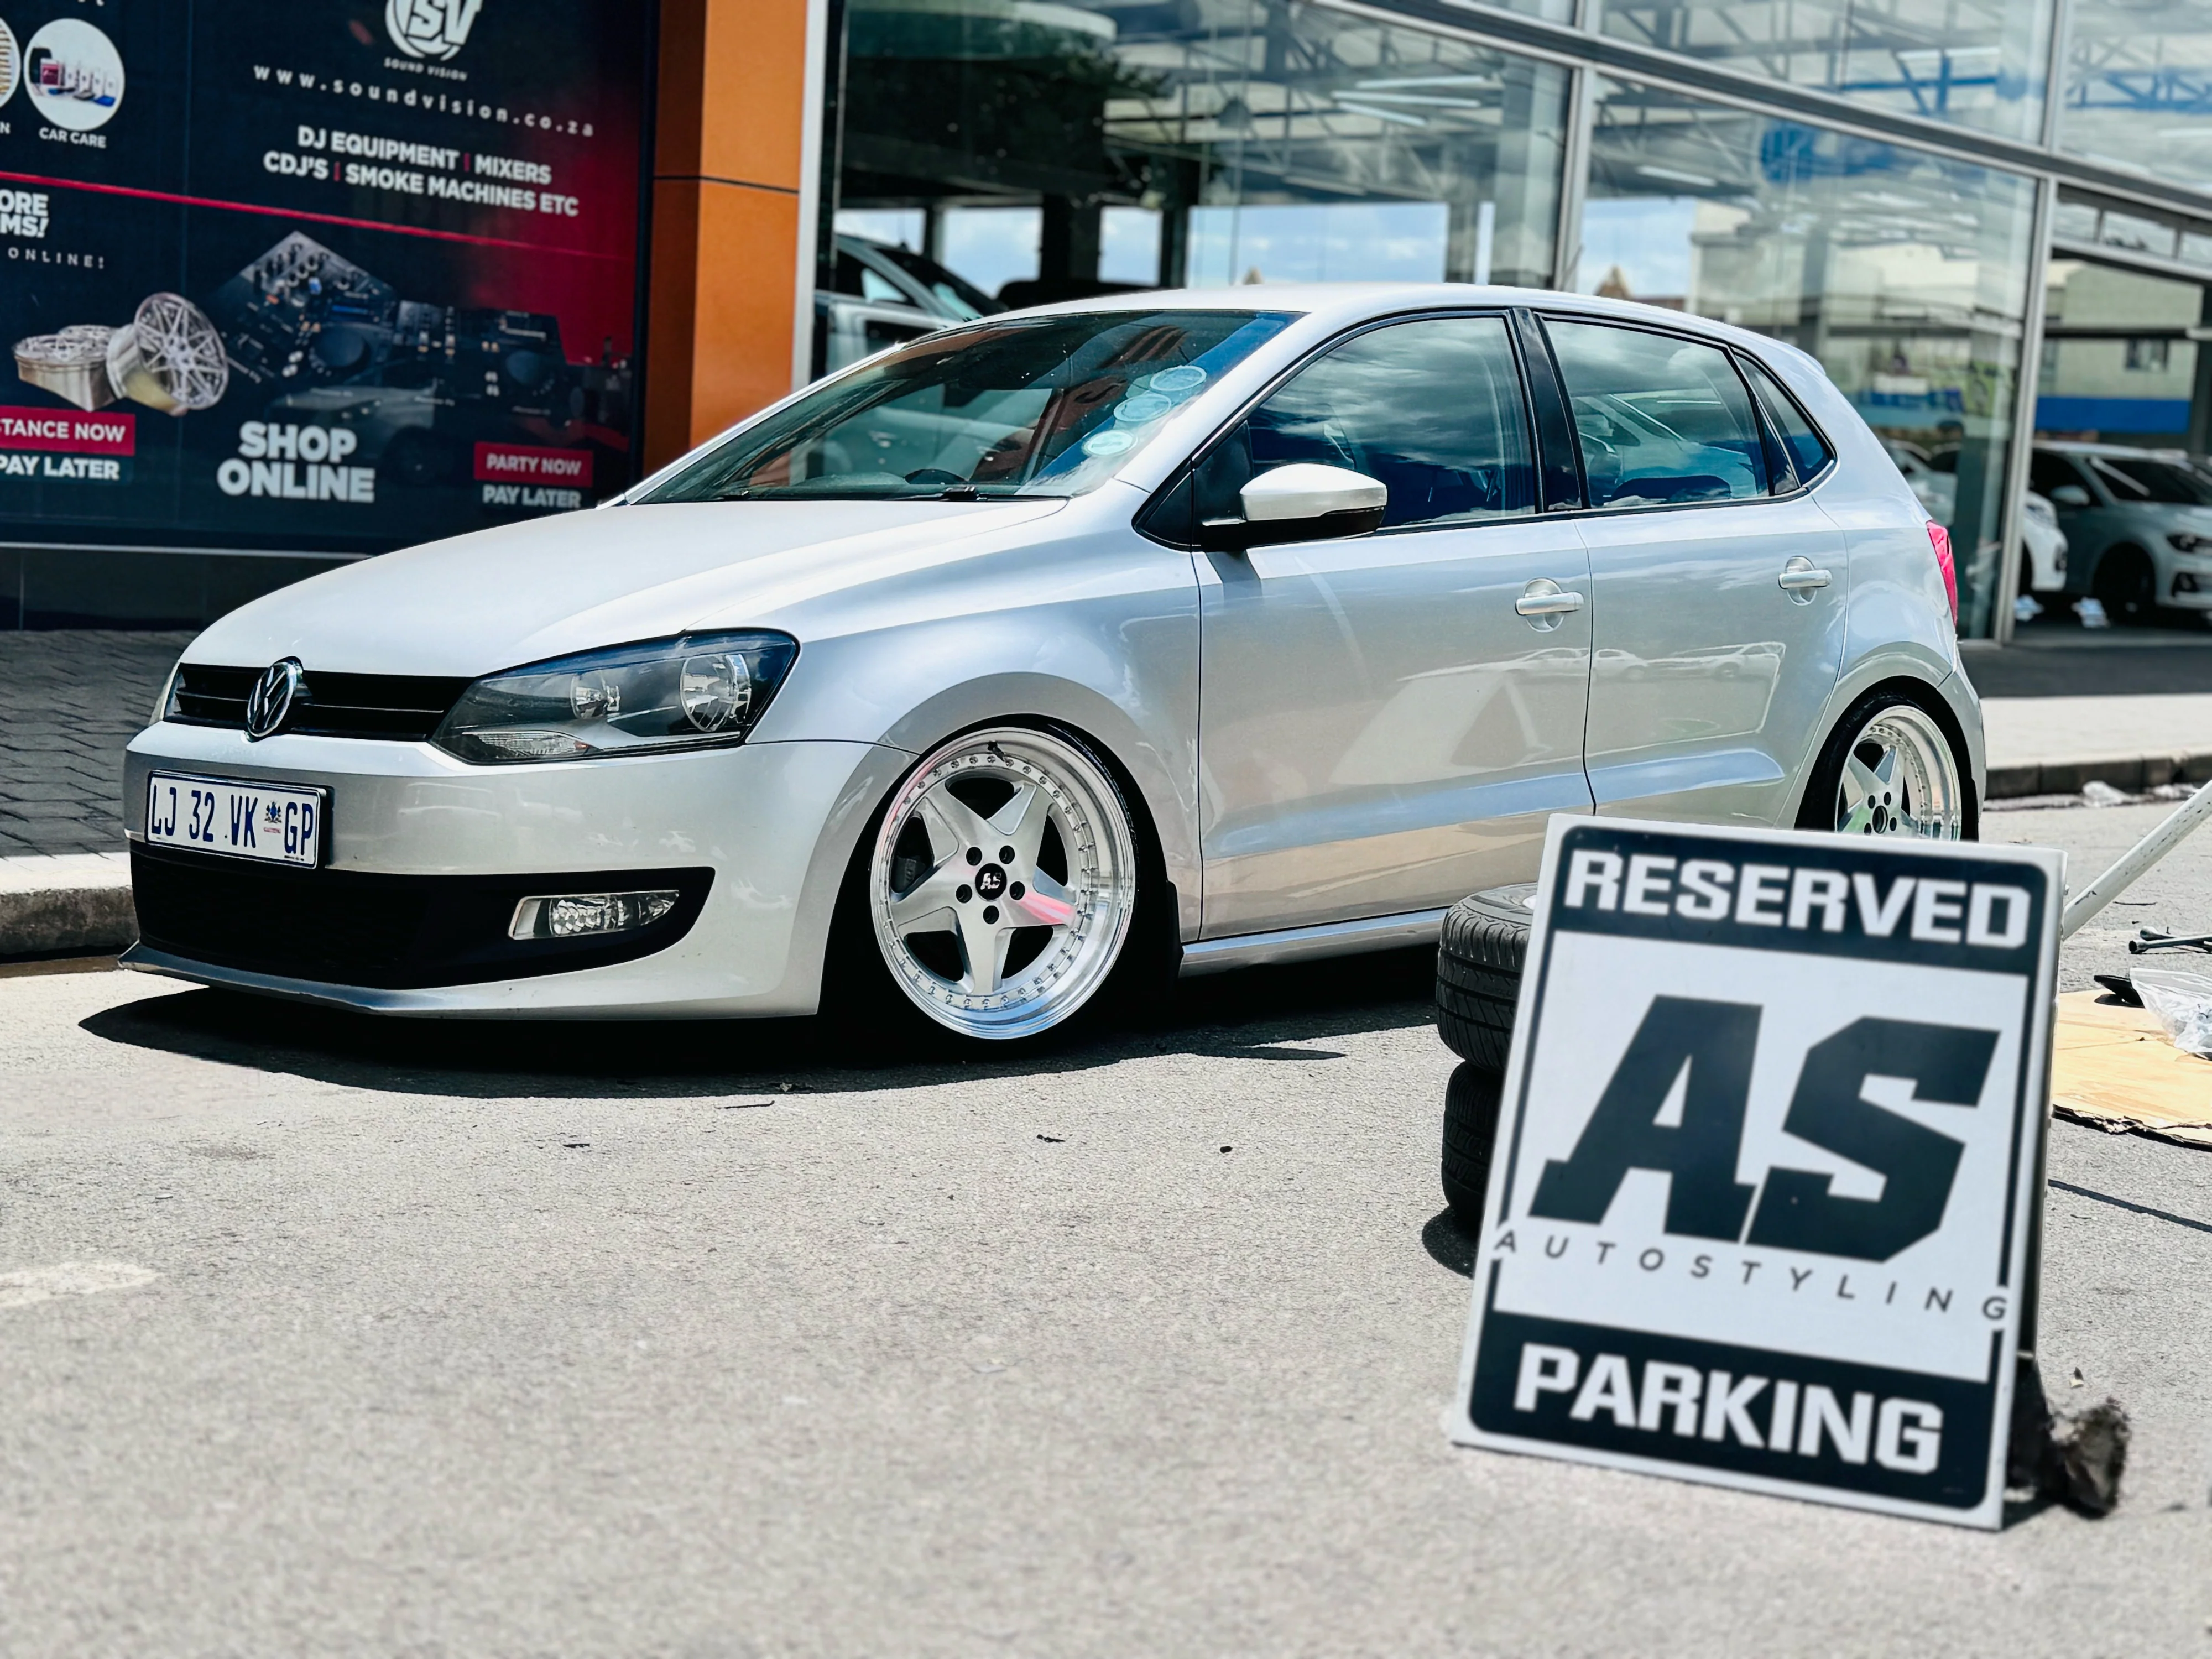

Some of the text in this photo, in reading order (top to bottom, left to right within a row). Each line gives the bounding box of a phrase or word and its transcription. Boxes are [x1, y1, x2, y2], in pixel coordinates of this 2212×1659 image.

[383, 56, 468, 82] SOUND VISION
[253, 65, 594, 137] www.soundvision.co.za
[38, 127, 107, 149] CAR CARE
[298, 125, 552, 186] DJ EQUIPMENT MIXERS
[263, 151, 580, 217] CDJ'S SMOKE MACHINES ETC
[7, 247, 105, 269] ONLINE!
[0, 418, 126, 443] TANCE NOW
[238, 420, 358, 463] SHOP
[44, 455, 120, 481] LATER
[216, 458, 375, 503] ONLINE
[486, 452, 582, 476] PARTY NOW
[482, 484, 582, 509] PAY LATER
[151, 783, 314, 856] LJ 32 VK GP
[1563, 849, 2032, 949] RESERVED
[1527, 994, 2001, 1264] AS
[1493, 1228, 2008, 1321] AUTOSTYLING
[1513, 1342, 1944, 1475] PARKING
